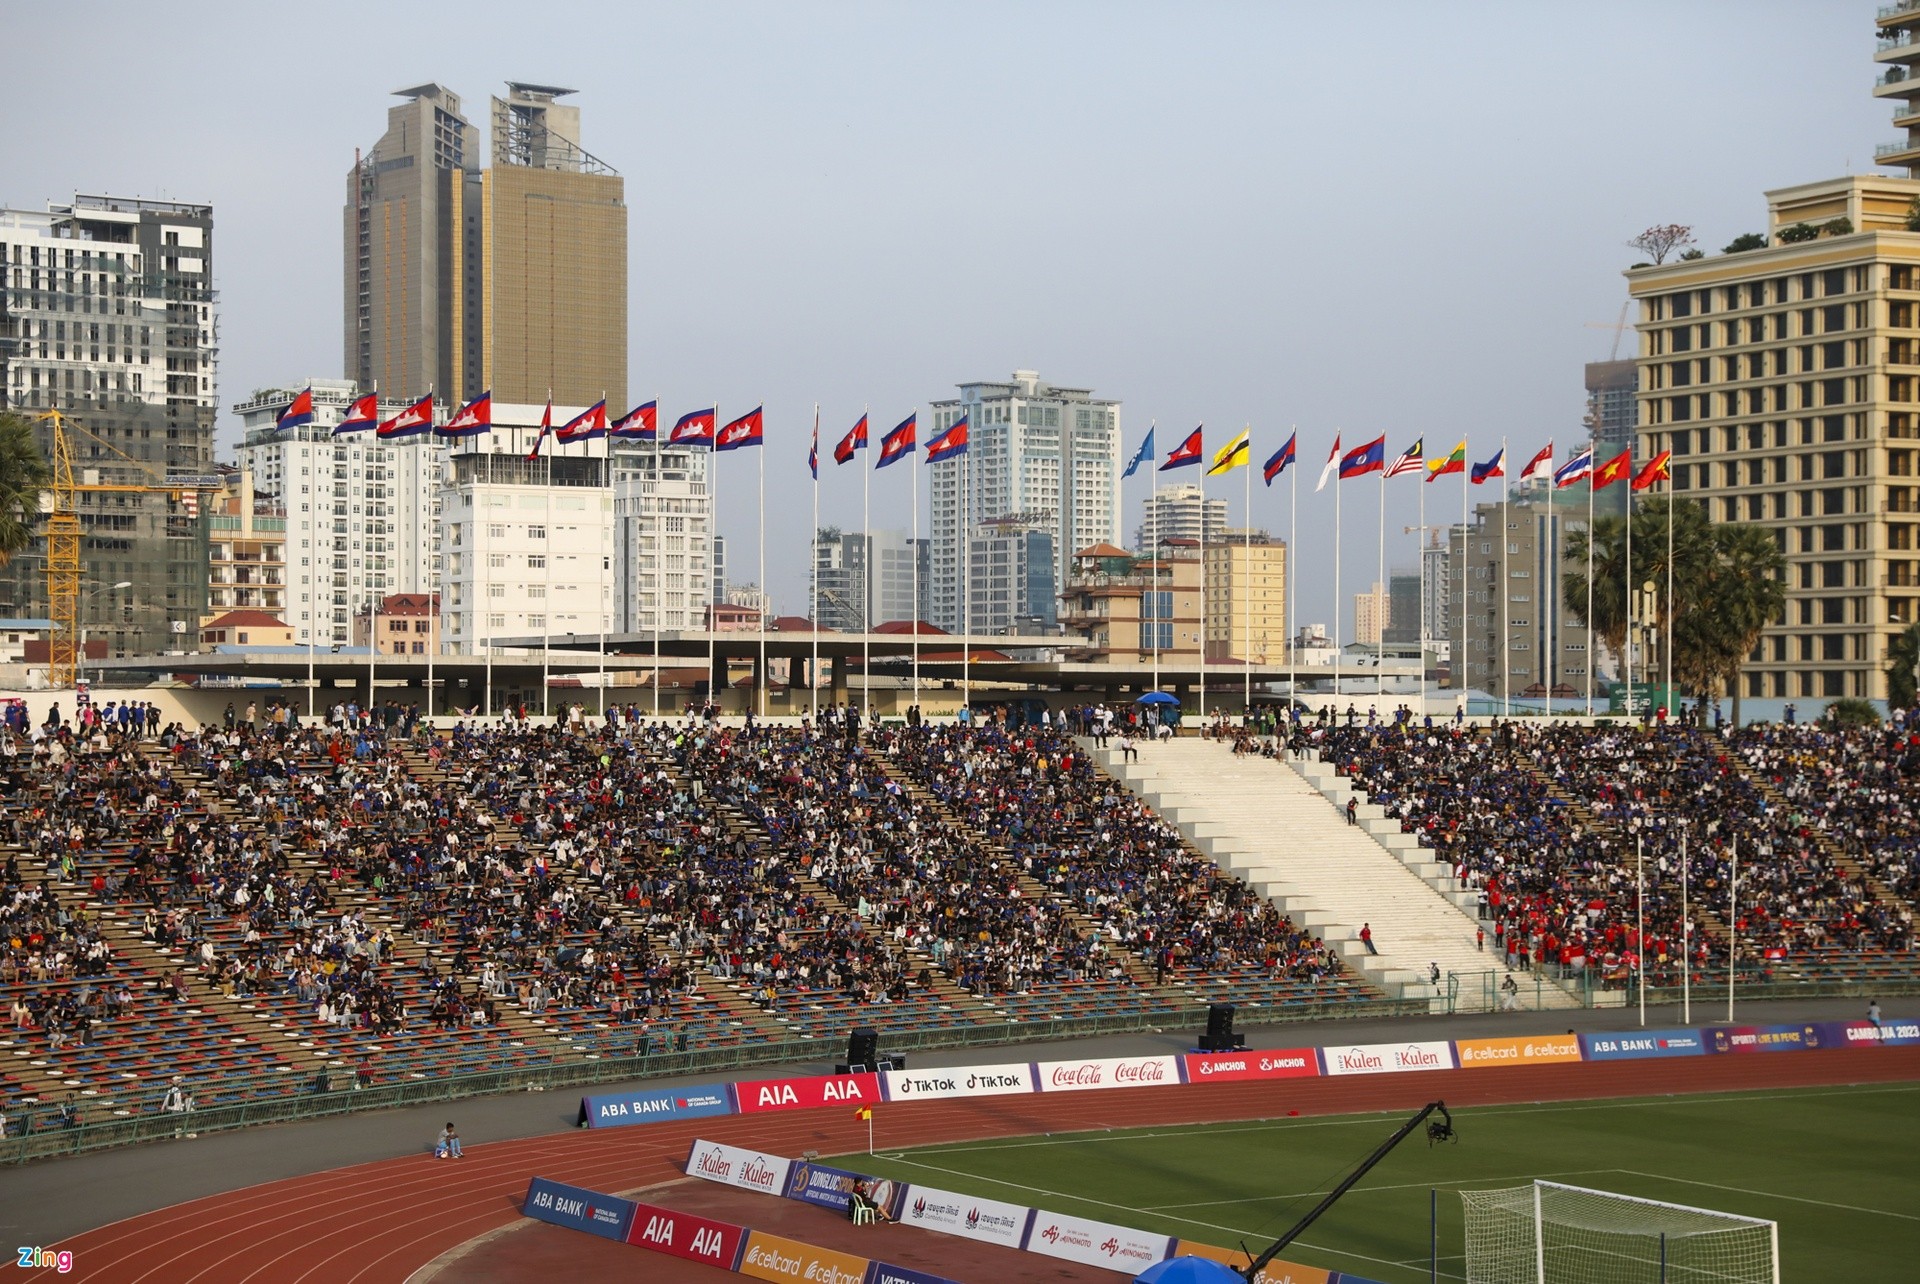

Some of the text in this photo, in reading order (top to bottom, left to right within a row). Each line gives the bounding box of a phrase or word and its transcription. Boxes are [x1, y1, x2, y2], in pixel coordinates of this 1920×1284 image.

[1896, 1025, 1920, 1038] 2023
[1473, 1045, 1518, 1060] cellcard
[1534, 1042, 1578, 1057] cellcard
[1594, 1039, 1653, 1052] ABA BANK
[1273, 1058, 1305, 1069] ANCHOR
[1344, 1053, 1382, 1069] Kulen
[1401, 1050, 1438, 1065] Kulen
[1214, 1061, 1246, 1072] ANCHOR
[914, 1078, 956, 1092] TikTok
[979, 1075, 1021, 1088] TikTok
[758, 1086, 798, 1106] AIA
[823, 1080, 862, 1101] AIA
[601, 1099, 670, 1117] ABA BANK
[701, 1153, 731, 1176] Kulen
[743, 1162, 774, 1186] Kulen
[533, 1191, 583, 1217] ABA BANK
[642, 1215, 674, 1246] AIA
[690, 1226, 722, 1258] AIA
[1060, 1235, 1091, 1248] AJINOMOTO
[1119, 1247, 1153, 1260] AJINOMOTO
[757, 1250, 802, 1276] cellcard
[815, 1265, 863, 1284] cellcard
